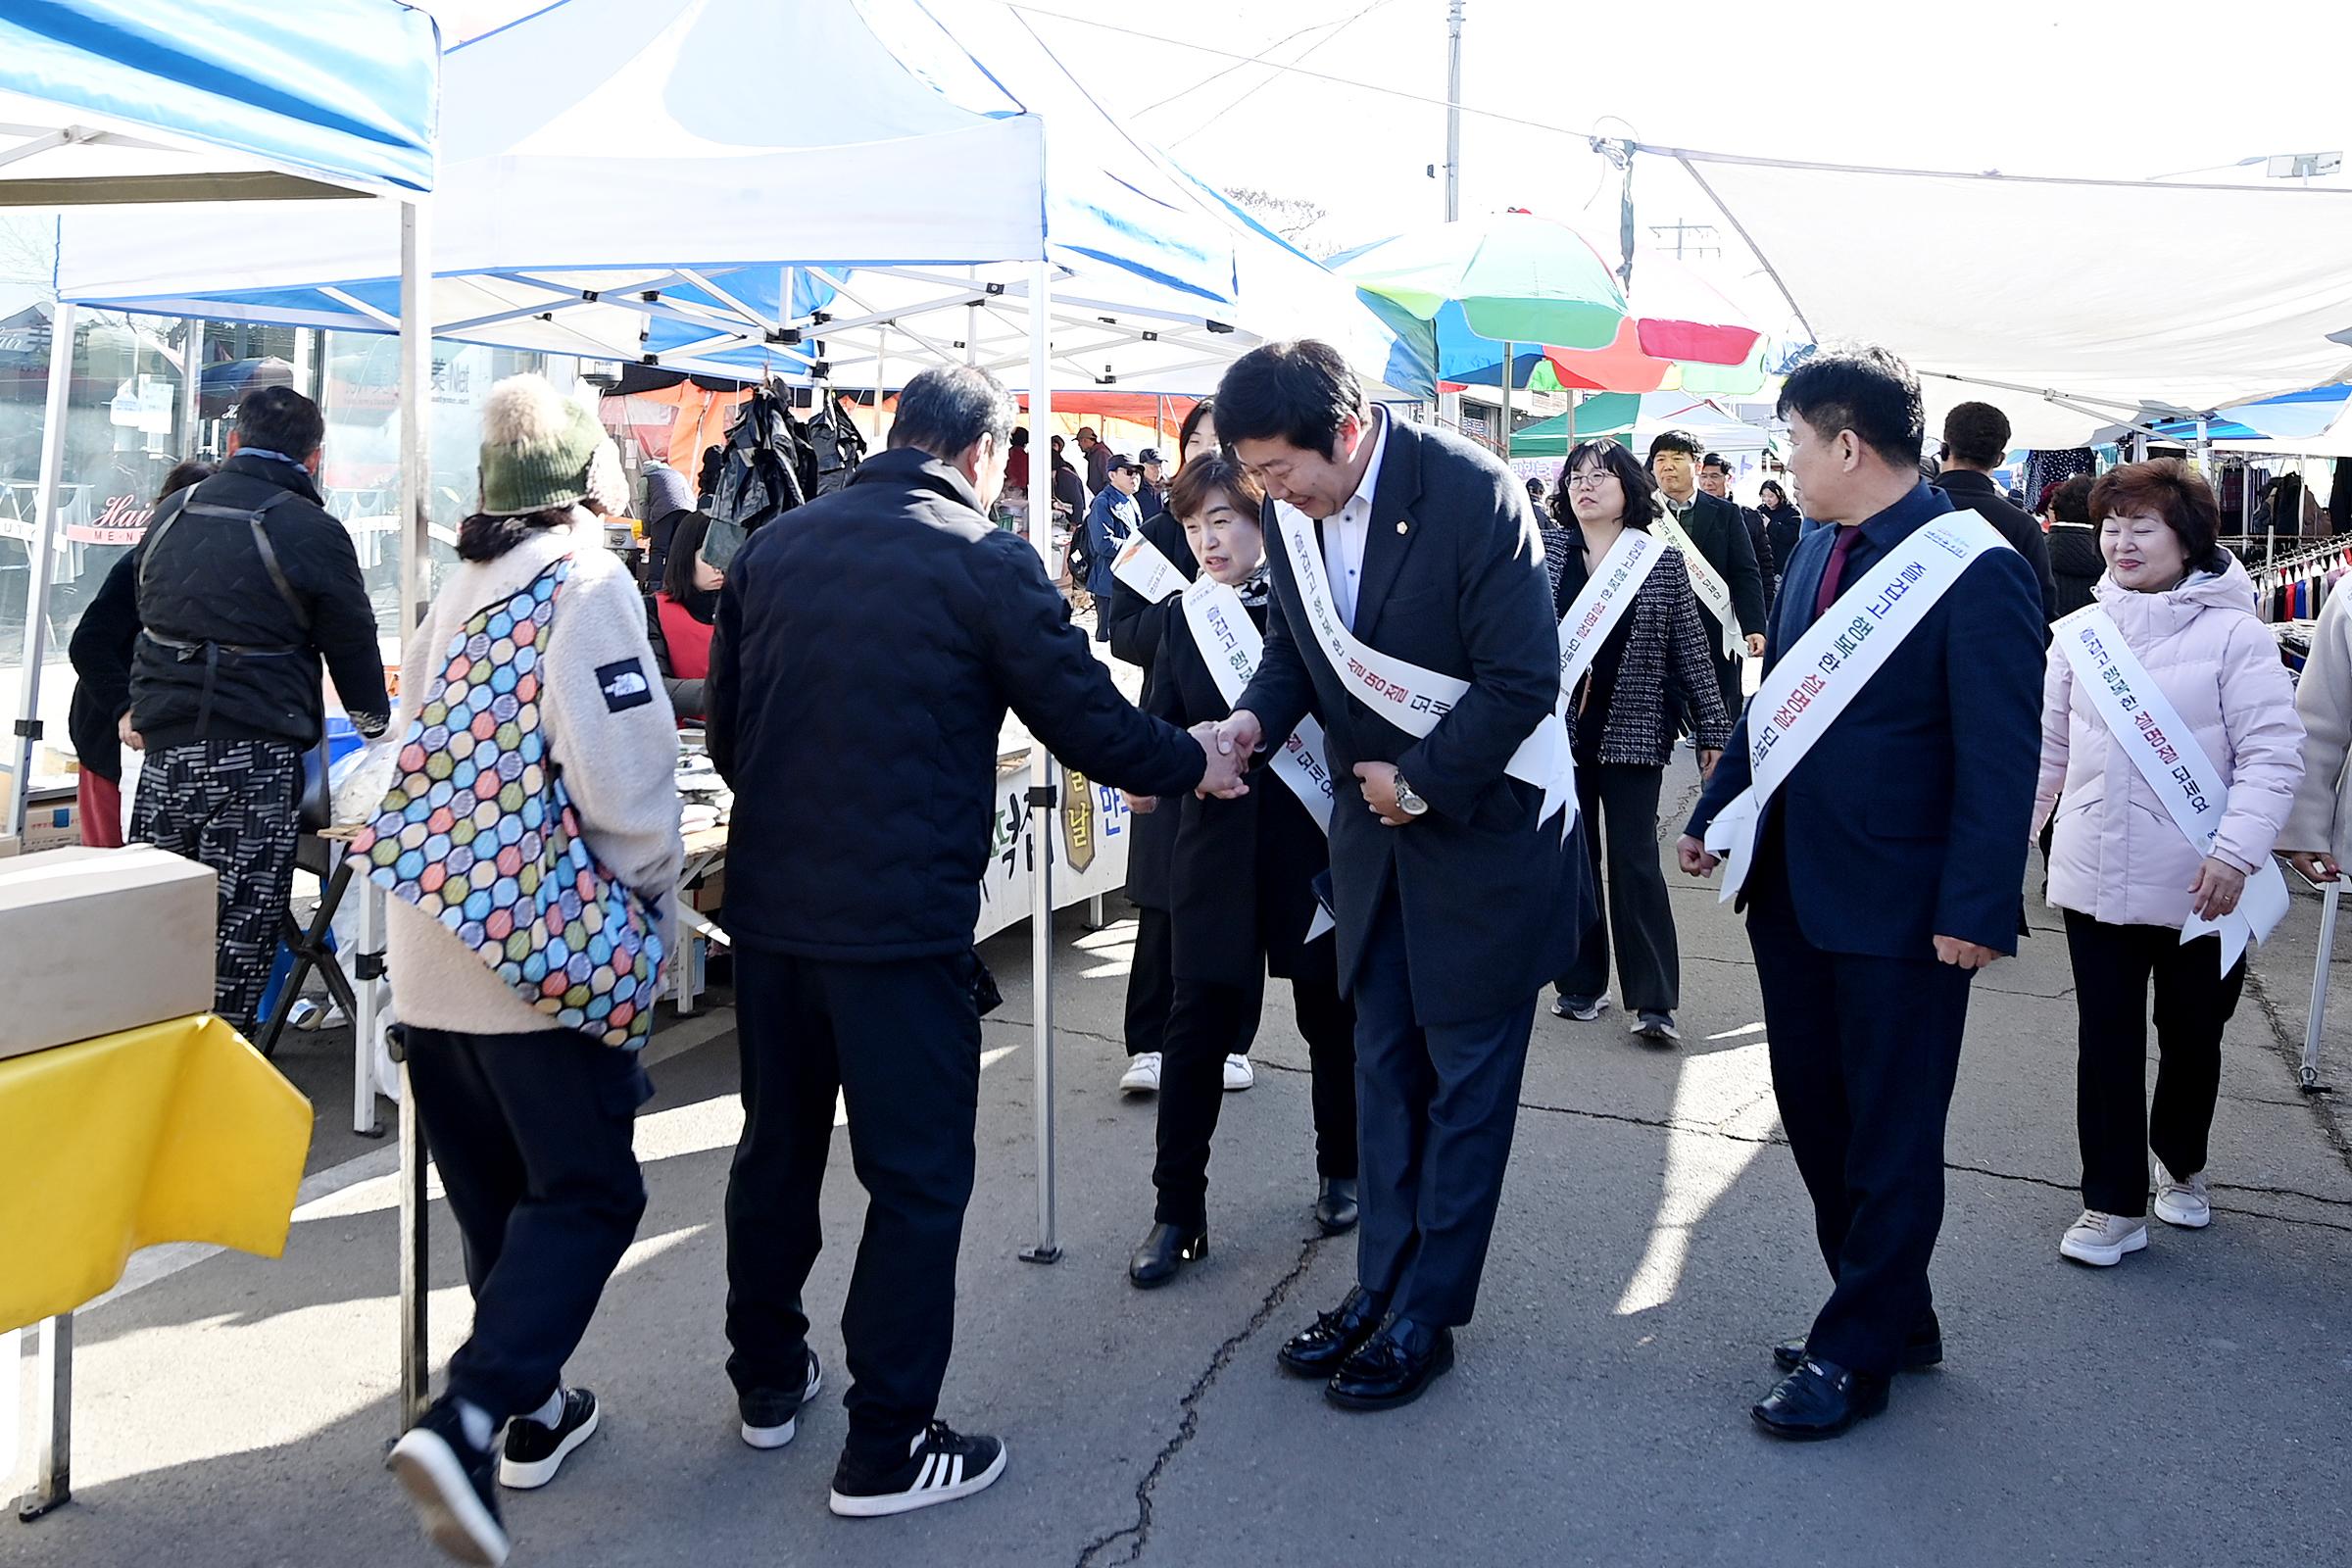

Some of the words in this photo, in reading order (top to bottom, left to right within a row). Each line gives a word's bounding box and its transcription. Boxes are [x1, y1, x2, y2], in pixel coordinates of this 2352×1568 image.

[1600, 568, 1628, 602] 행복한
[1866, 561, 1928, 619] 즐겁고
[1293, 529, 1318, 595] 즐겁고
[1313, 595, 1345, 658] 행복한
[1347, 657, 1408, 704] 설명절
[1576, 601, 1606, 640] 설명절
[1818, 615, 1874, 675] 행복한
[1773, 673, 1826, 730] 설명절
[2079, 626, 2110, 670] 즐겁고
[2102, 663, 2139, 712] 행복한
[2134, 710, 2180, 764] 설명절
[2172, 765, 2211, 815] 되세요
[1100, 785, 1130, 837] 만
